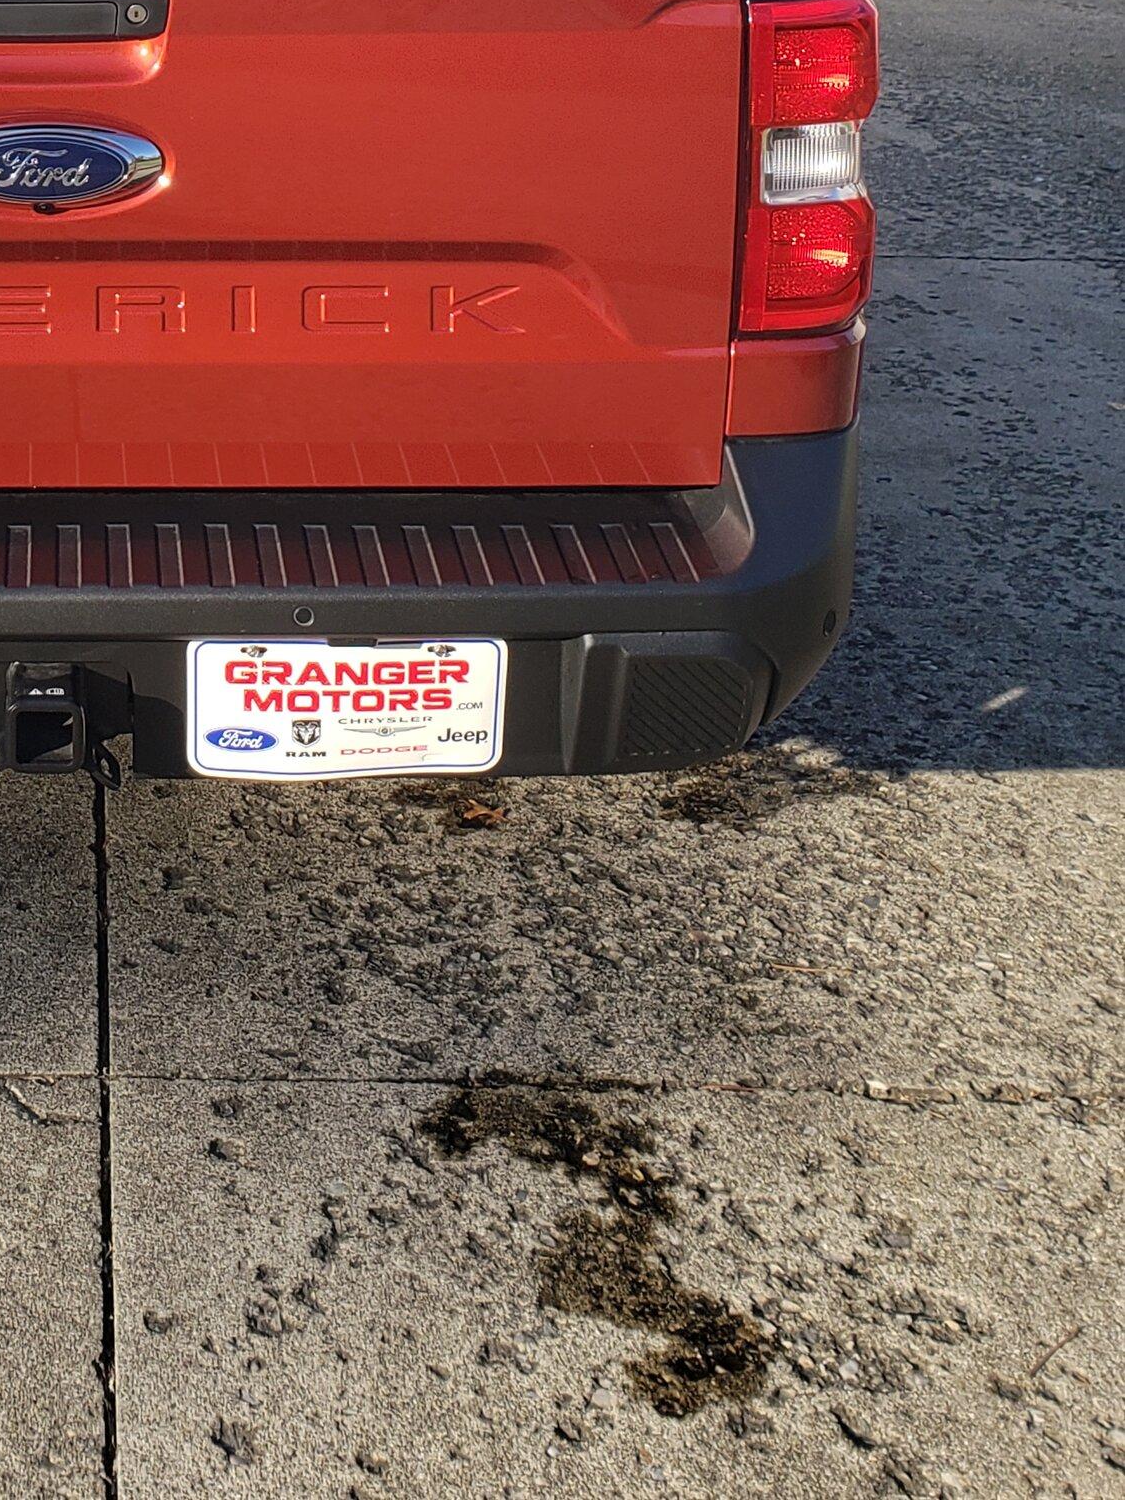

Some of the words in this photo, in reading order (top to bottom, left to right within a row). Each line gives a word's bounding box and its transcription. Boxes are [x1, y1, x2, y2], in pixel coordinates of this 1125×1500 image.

[224, 659, 470, 686] GRANGER
[243, 687, 453, 713] MOTORS
[338, 716, 433, 725] CHRYSLER
[218, 728, 265, 750] Ford
[437, 727, 488, 744] Jeep
[285, 750, 327, 758] RAM
[340, 744, 428, 756] DODGE
